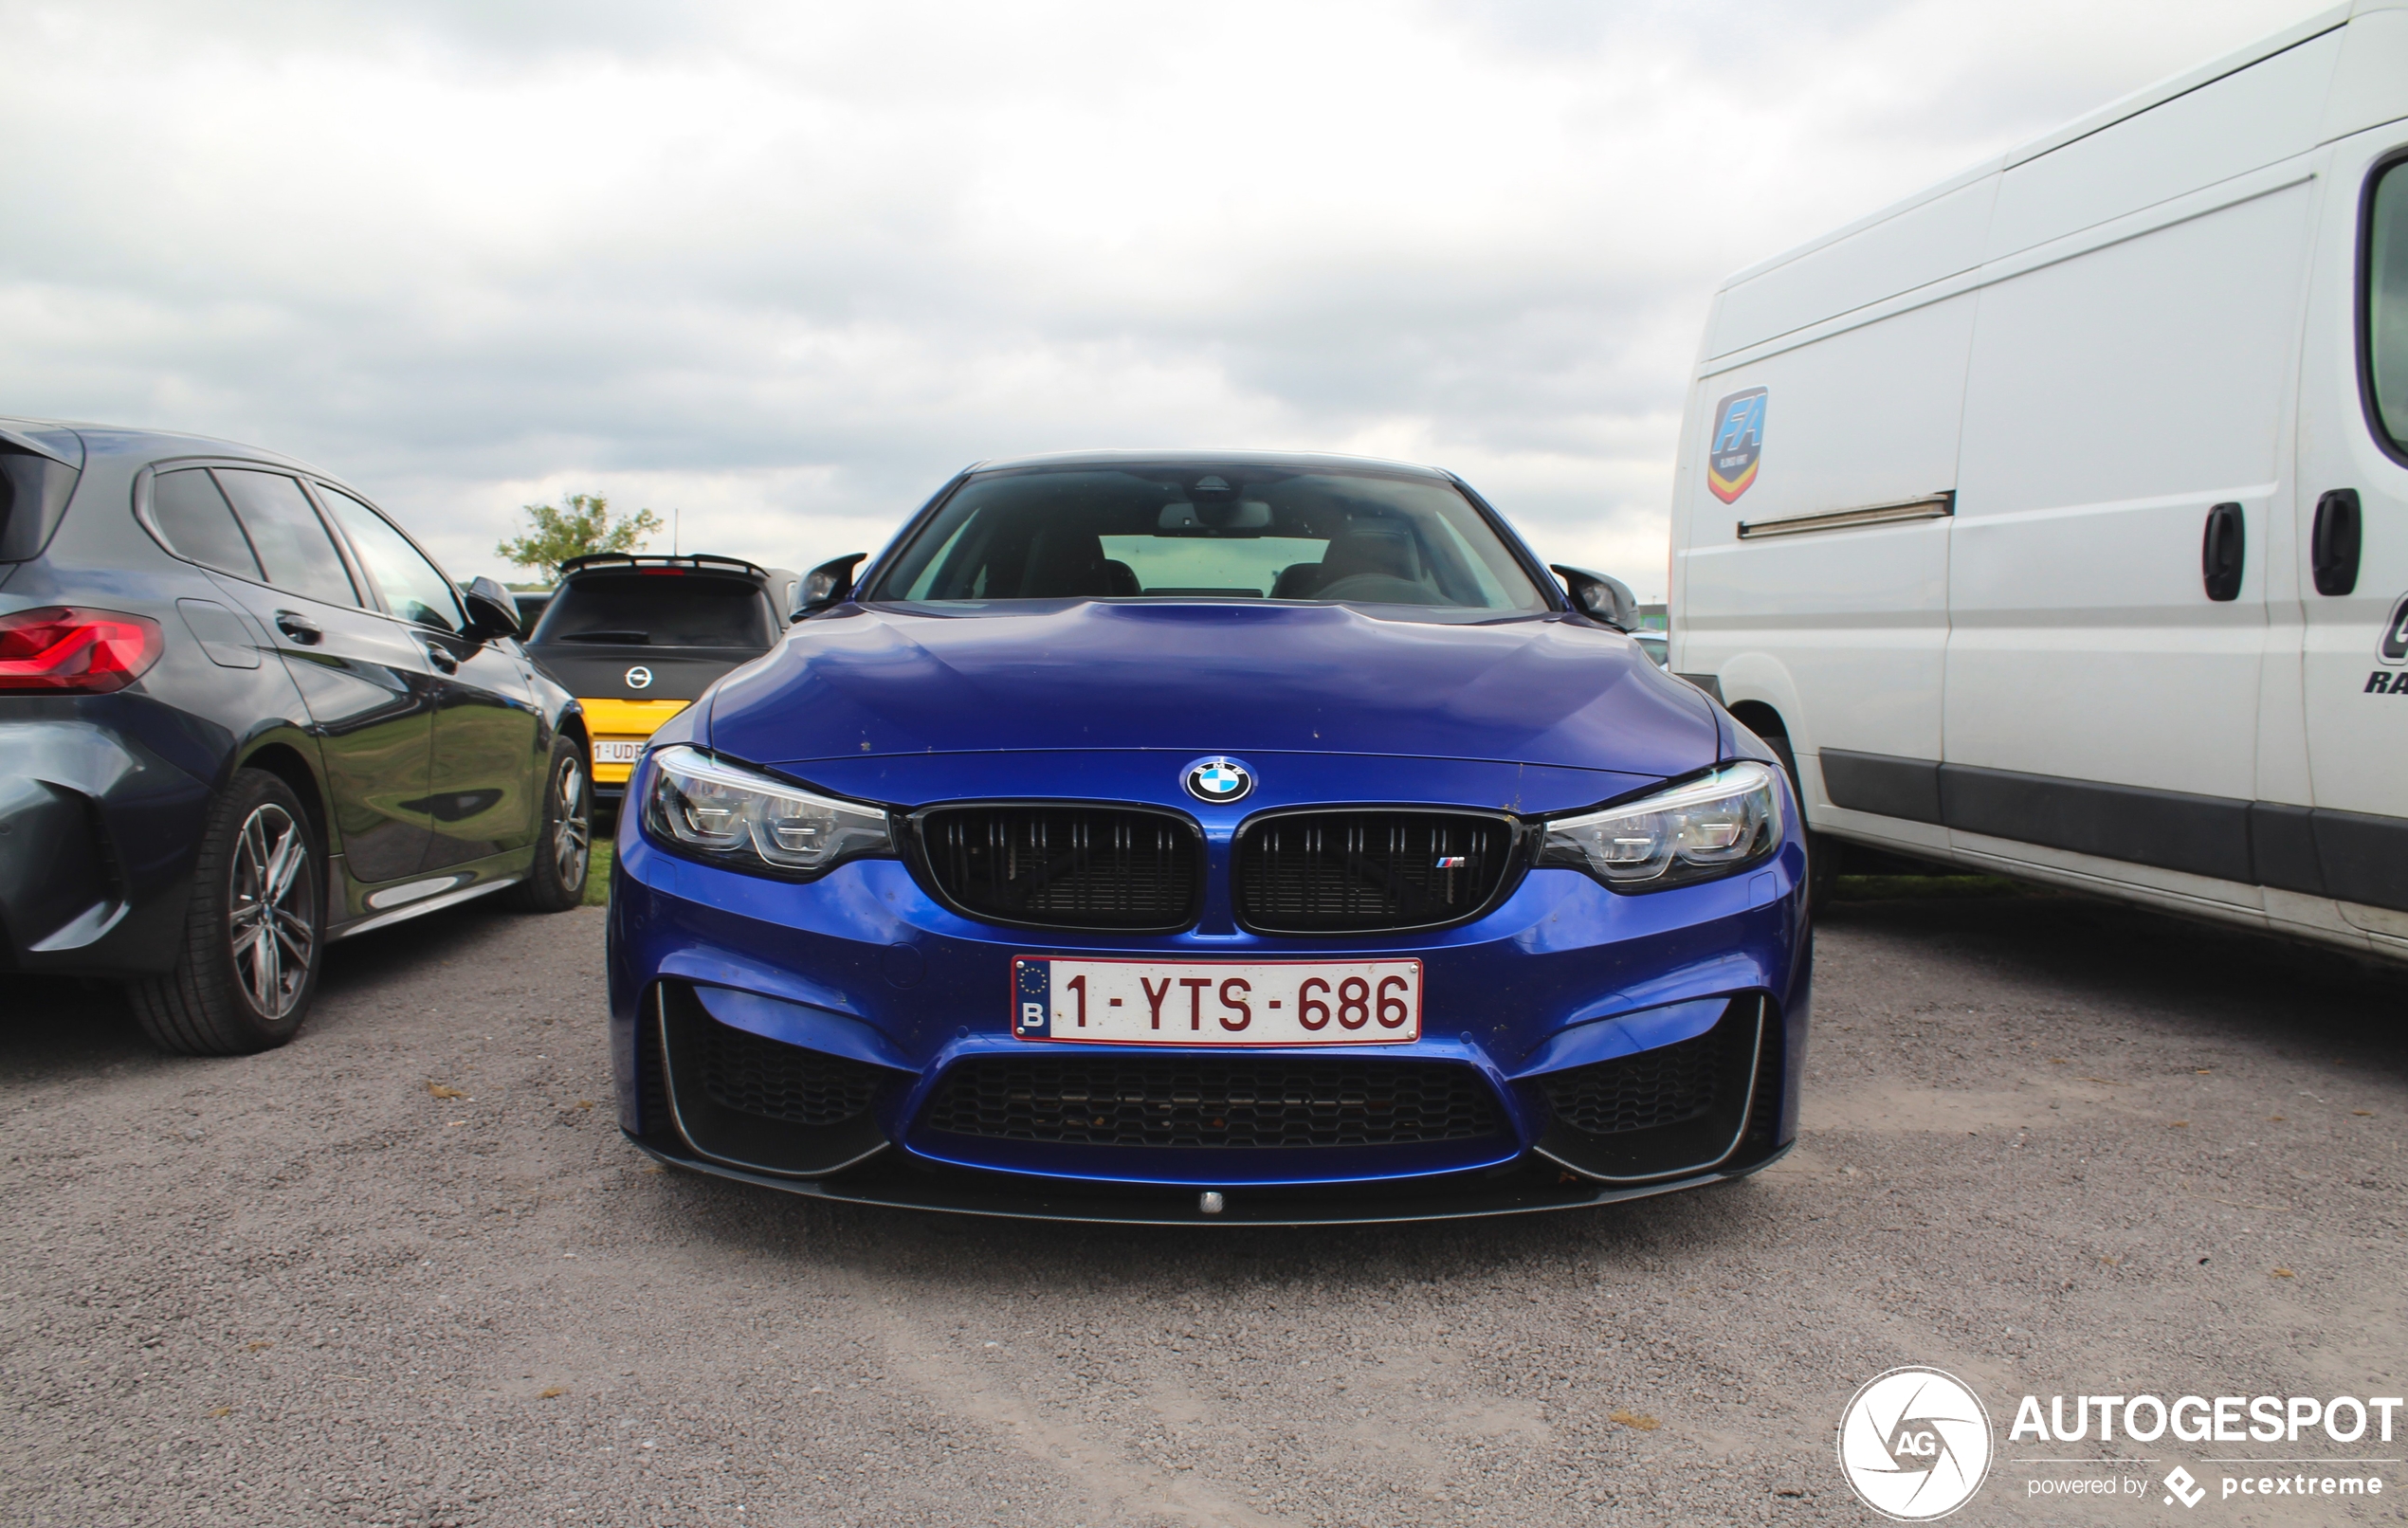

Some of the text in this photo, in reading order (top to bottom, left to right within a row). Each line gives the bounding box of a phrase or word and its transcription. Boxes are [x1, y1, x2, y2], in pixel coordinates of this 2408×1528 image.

[1711, 392, 1766, 454] FA
[1194, 762, 1246, 775] BMW
[1023, 1003, 1044, 1028] B
